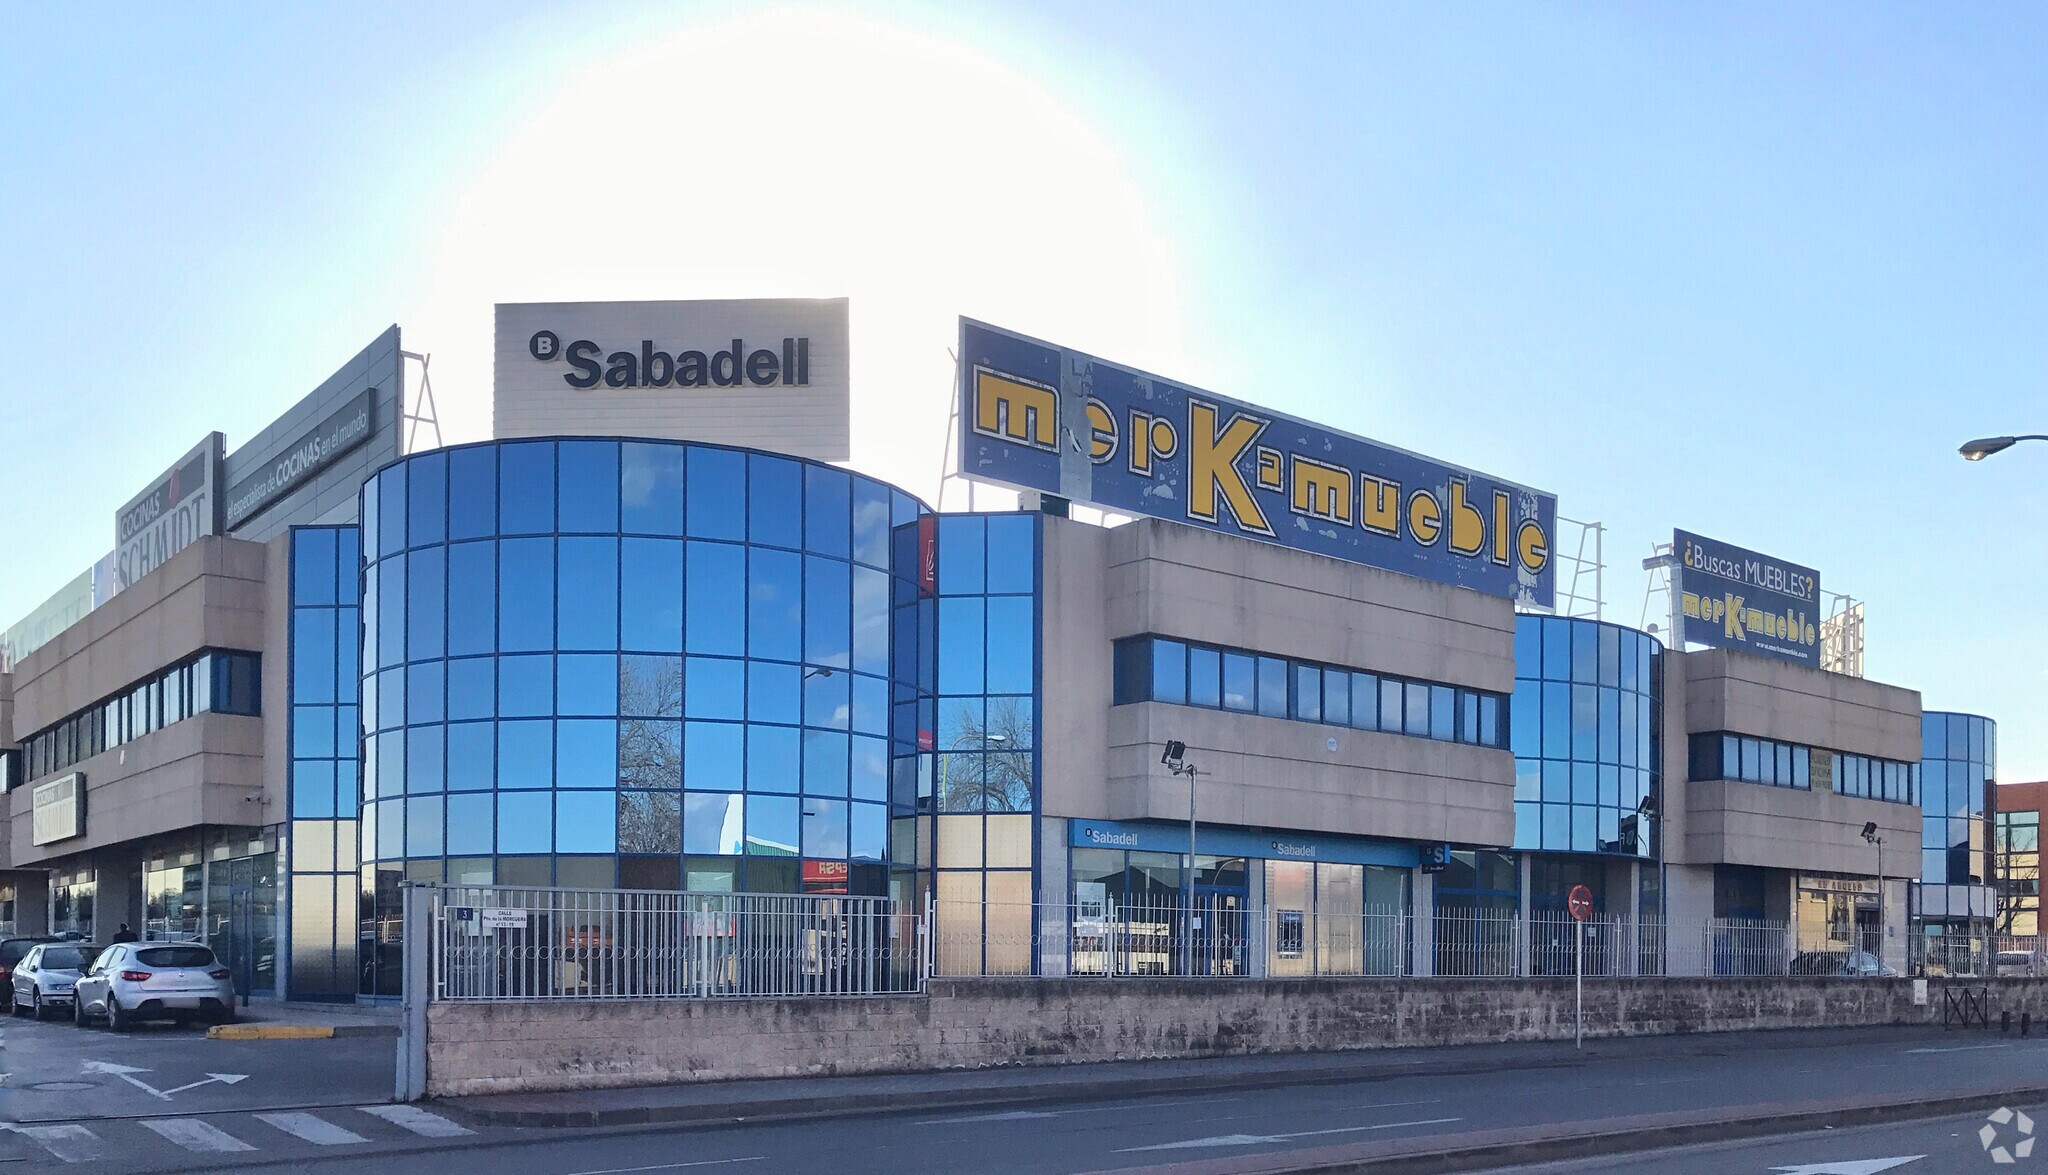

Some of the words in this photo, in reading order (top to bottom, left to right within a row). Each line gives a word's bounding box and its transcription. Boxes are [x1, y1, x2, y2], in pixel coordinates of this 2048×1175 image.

[563, 337, 810, 390] Sabadell
[233, 483, 267, 518] especialista
[267, 473, 276, 493] de
[275, 436, 321, 487] COCINAS
[321, 436, 331, 456] en
[331, 424, 339, 448] el
[339, 408, 367, 444] mundo
[119, 492, 206, 588] SCHMIDT
[120, 491, 160, 540] COCINAS
[1684, 541, 1741, 579] ¿Buscas
[1745, 559, 1813, 599] MUEBLES?
[1092, 830, 1138, 846] Sabadell
[1277, 843, 1316, 857] Sabadell
